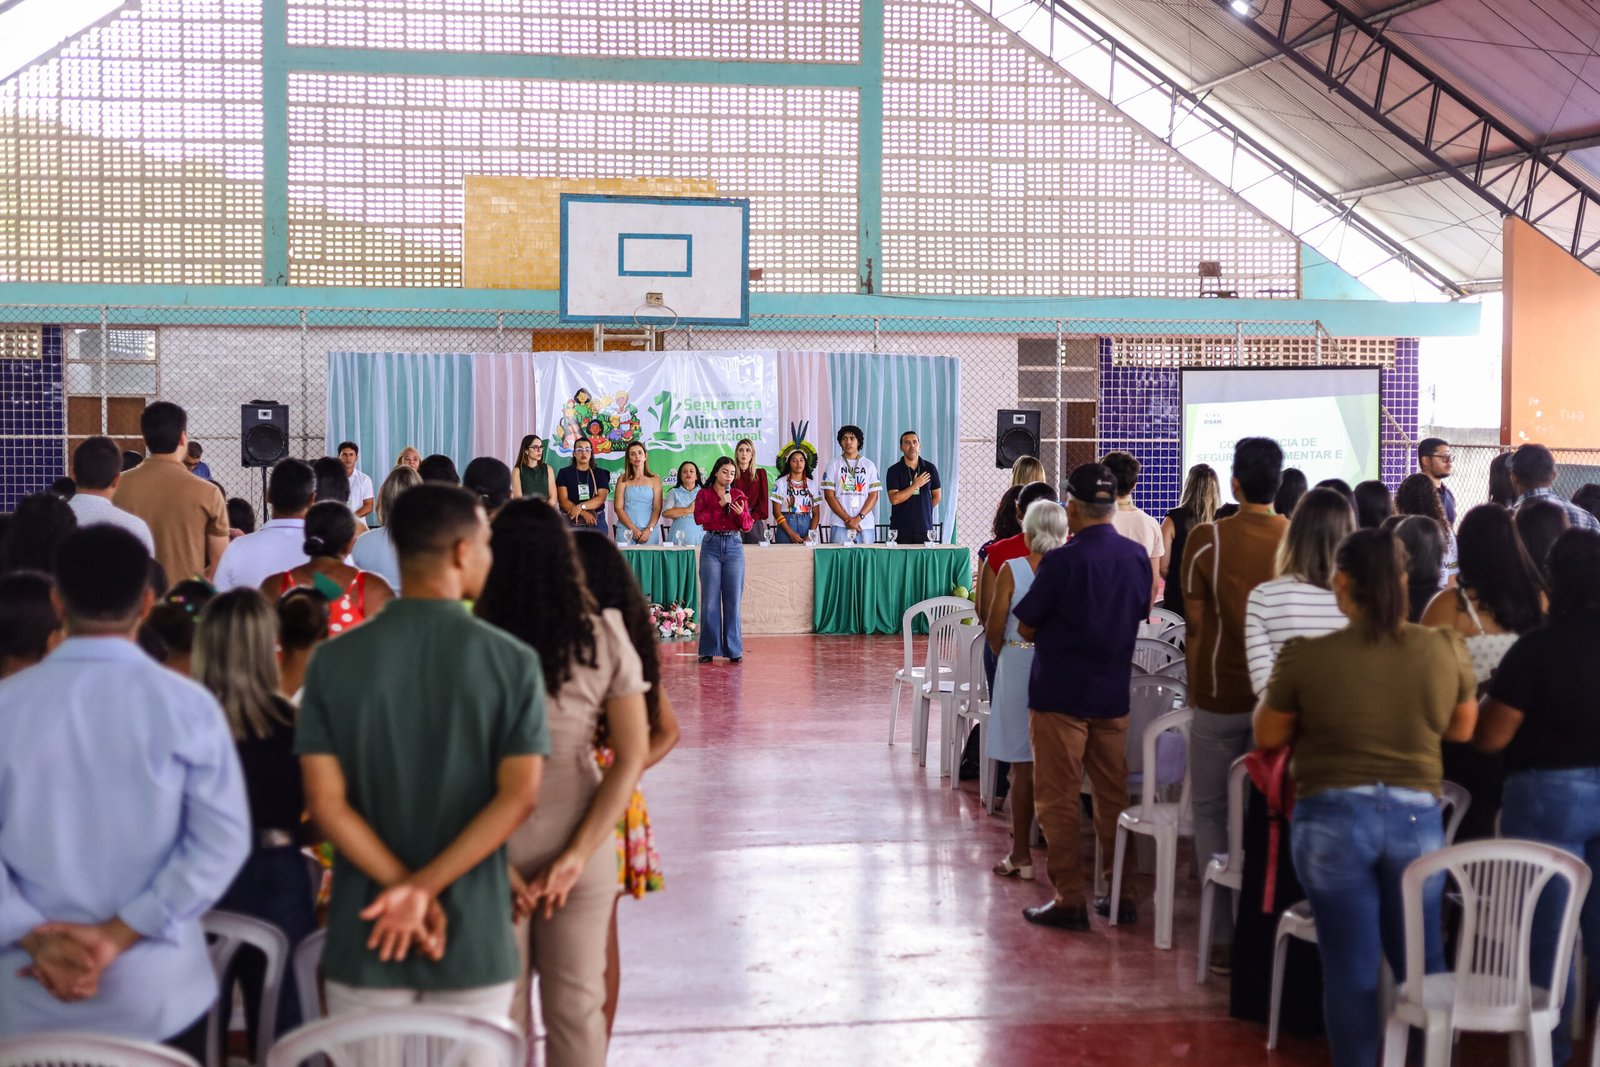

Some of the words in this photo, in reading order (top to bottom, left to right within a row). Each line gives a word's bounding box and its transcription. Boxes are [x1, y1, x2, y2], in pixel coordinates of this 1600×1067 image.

[684, 399, 762, 413] Segurança
[683, 415, 762, 429] Alimentar
[694, 430, 762, 442] Nutricional
